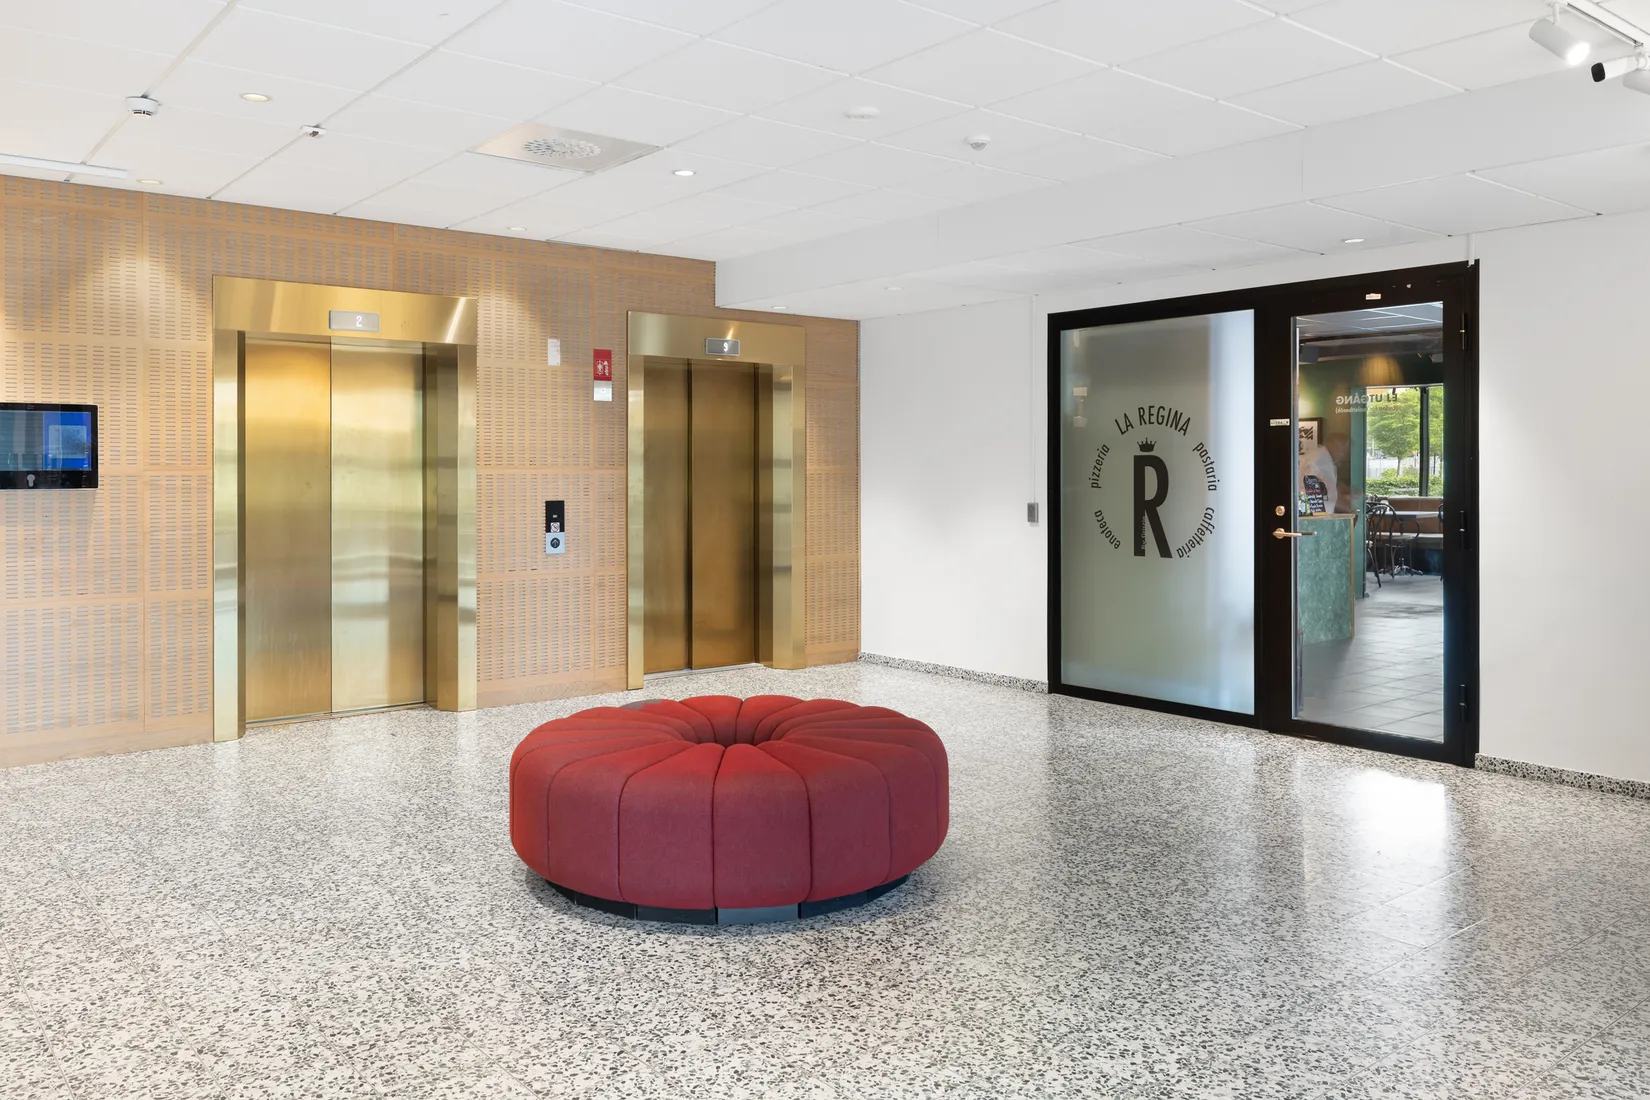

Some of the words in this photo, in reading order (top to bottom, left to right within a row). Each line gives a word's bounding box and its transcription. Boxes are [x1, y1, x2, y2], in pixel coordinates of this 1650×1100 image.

[356, 315, 363, 327] 2
[723, 342, 729, 352] 9
[1114, 412, 1134, 435] LA
[1138, 405, 1191, 436] REGINA
[1088, 443, 1110, 489] pizzeria
[1192, 442, 1220, 491] pastaria
[1133, 454, 1173, 559] R
[1094, 509, 1121, 549] enoteca
[1176, 507, 1215, 558] caffetteria
